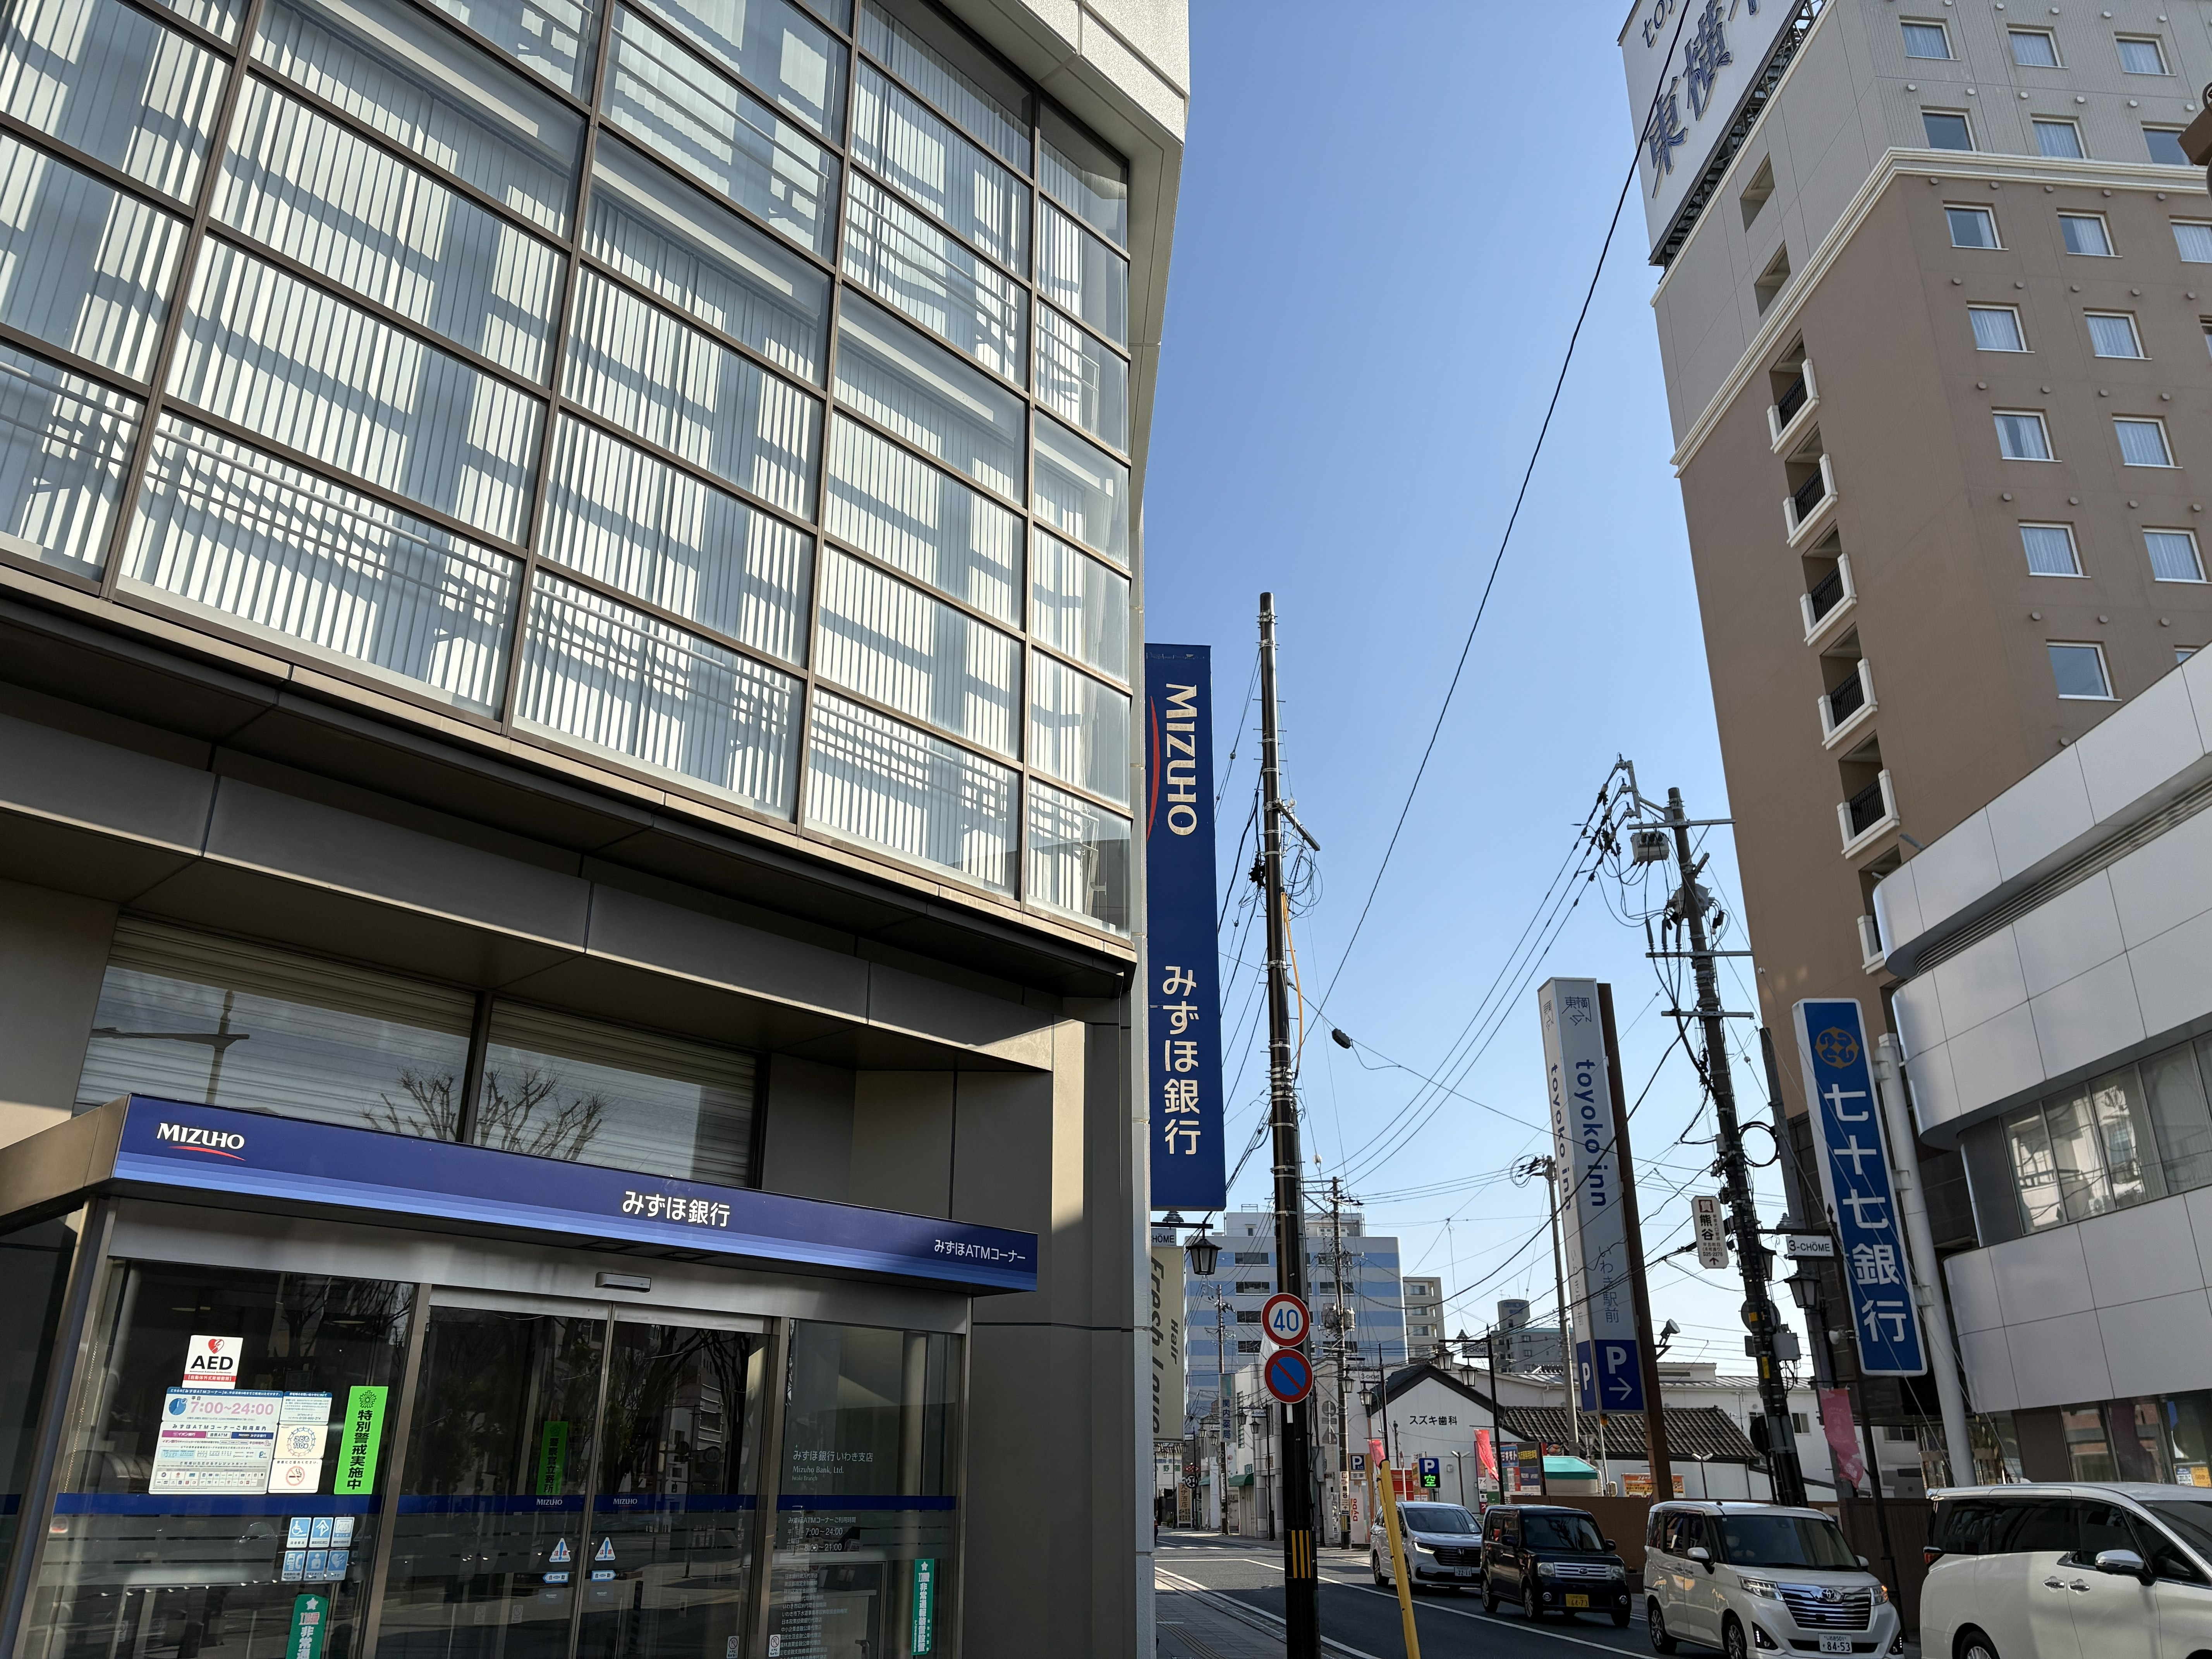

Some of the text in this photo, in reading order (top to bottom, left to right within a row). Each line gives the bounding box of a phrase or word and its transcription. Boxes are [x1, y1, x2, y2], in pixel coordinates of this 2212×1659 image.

[1166, 683, 1197, 835] MIZUHO
[1163, 966, 1201, 1155] みずほ銀行
[156, 1122, 245, 1150] MIZUHO
[1551, 1063, 1571, 1211] toyoko inn
[1574, 1059, 1608, 1207] toyoko inn
[622, 1190, 730, 1228] みずほ銀行
[1824, 1084, 1906, 1342] 七十七銀行
[1700, 1214, 1714, 1240] 熊谷
[934, 1239, 1026, 1262] みずほATMコーナー
[1273, 1309, 1299, 1332] 40
[190, 1355, 233, 1370] AED
[1606, 1346, 1627, 1374] P
[1582, 1362, 1590, 1391] P
[190, 1401, 274, 1415] 7:00~24:00
[1222, 1398, 1231, 1439] 関内薬局
[1410, 1416, 1457, 1425] スズキ歯科
[347, 1410, 373, 1490] 特別警戒実施中
[793, 1450, 873, 1462] みずほ銀行 いわき支店
[1352, 1456, 1362, 1470] P
[816, 1466, 832, 1474] Bank,
[1424, 1459, 1435, 1473] P
[1424, 1474, 1436, 1487] 空
[1827, 1642, 1850, 1651] 84-53
